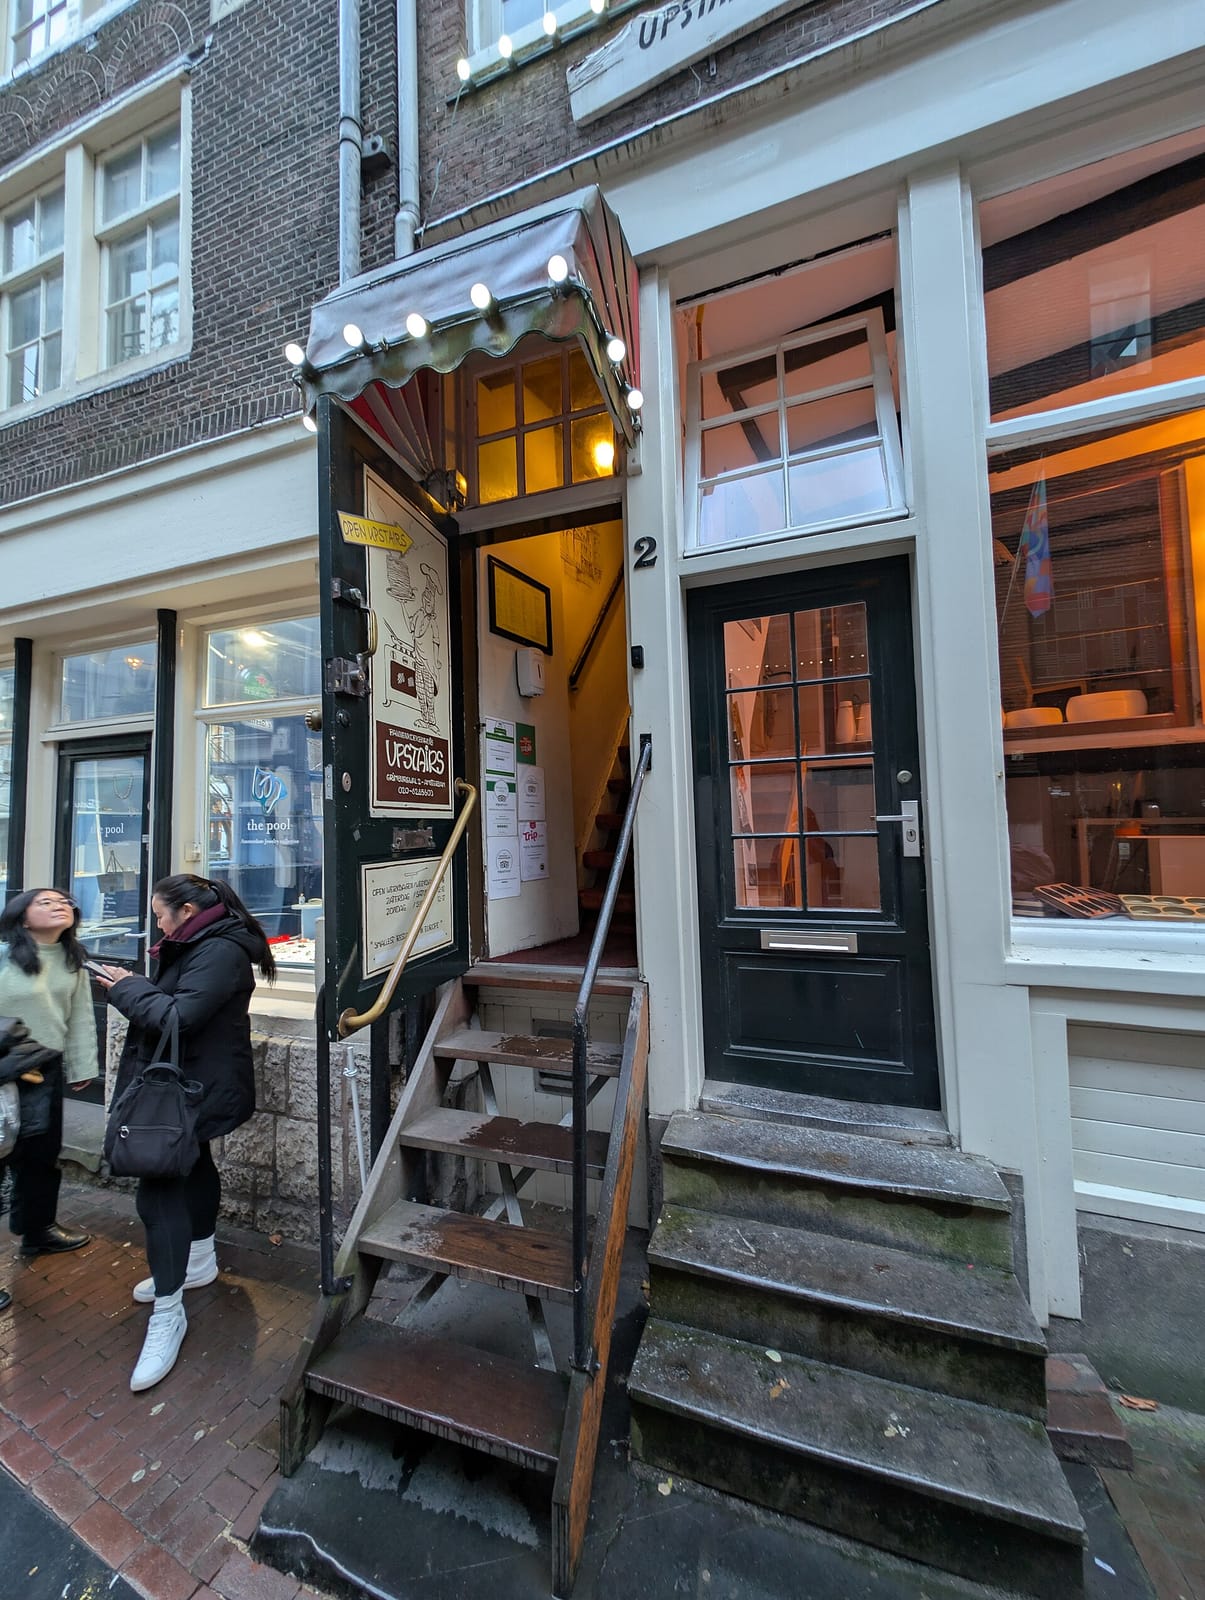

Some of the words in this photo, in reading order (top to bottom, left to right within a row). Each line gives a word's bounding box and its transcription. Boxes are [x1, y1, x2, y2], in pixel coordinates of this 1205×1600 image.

[342, 520, 366, 539] OPEN
[368, 527, 407, 547] UPSTAIRS
[634, 536, 658, 569] 2
[105, 822, 125, 838] pool
[247, 819, 264, 831] the
[266, 818, 291, 834] pool
